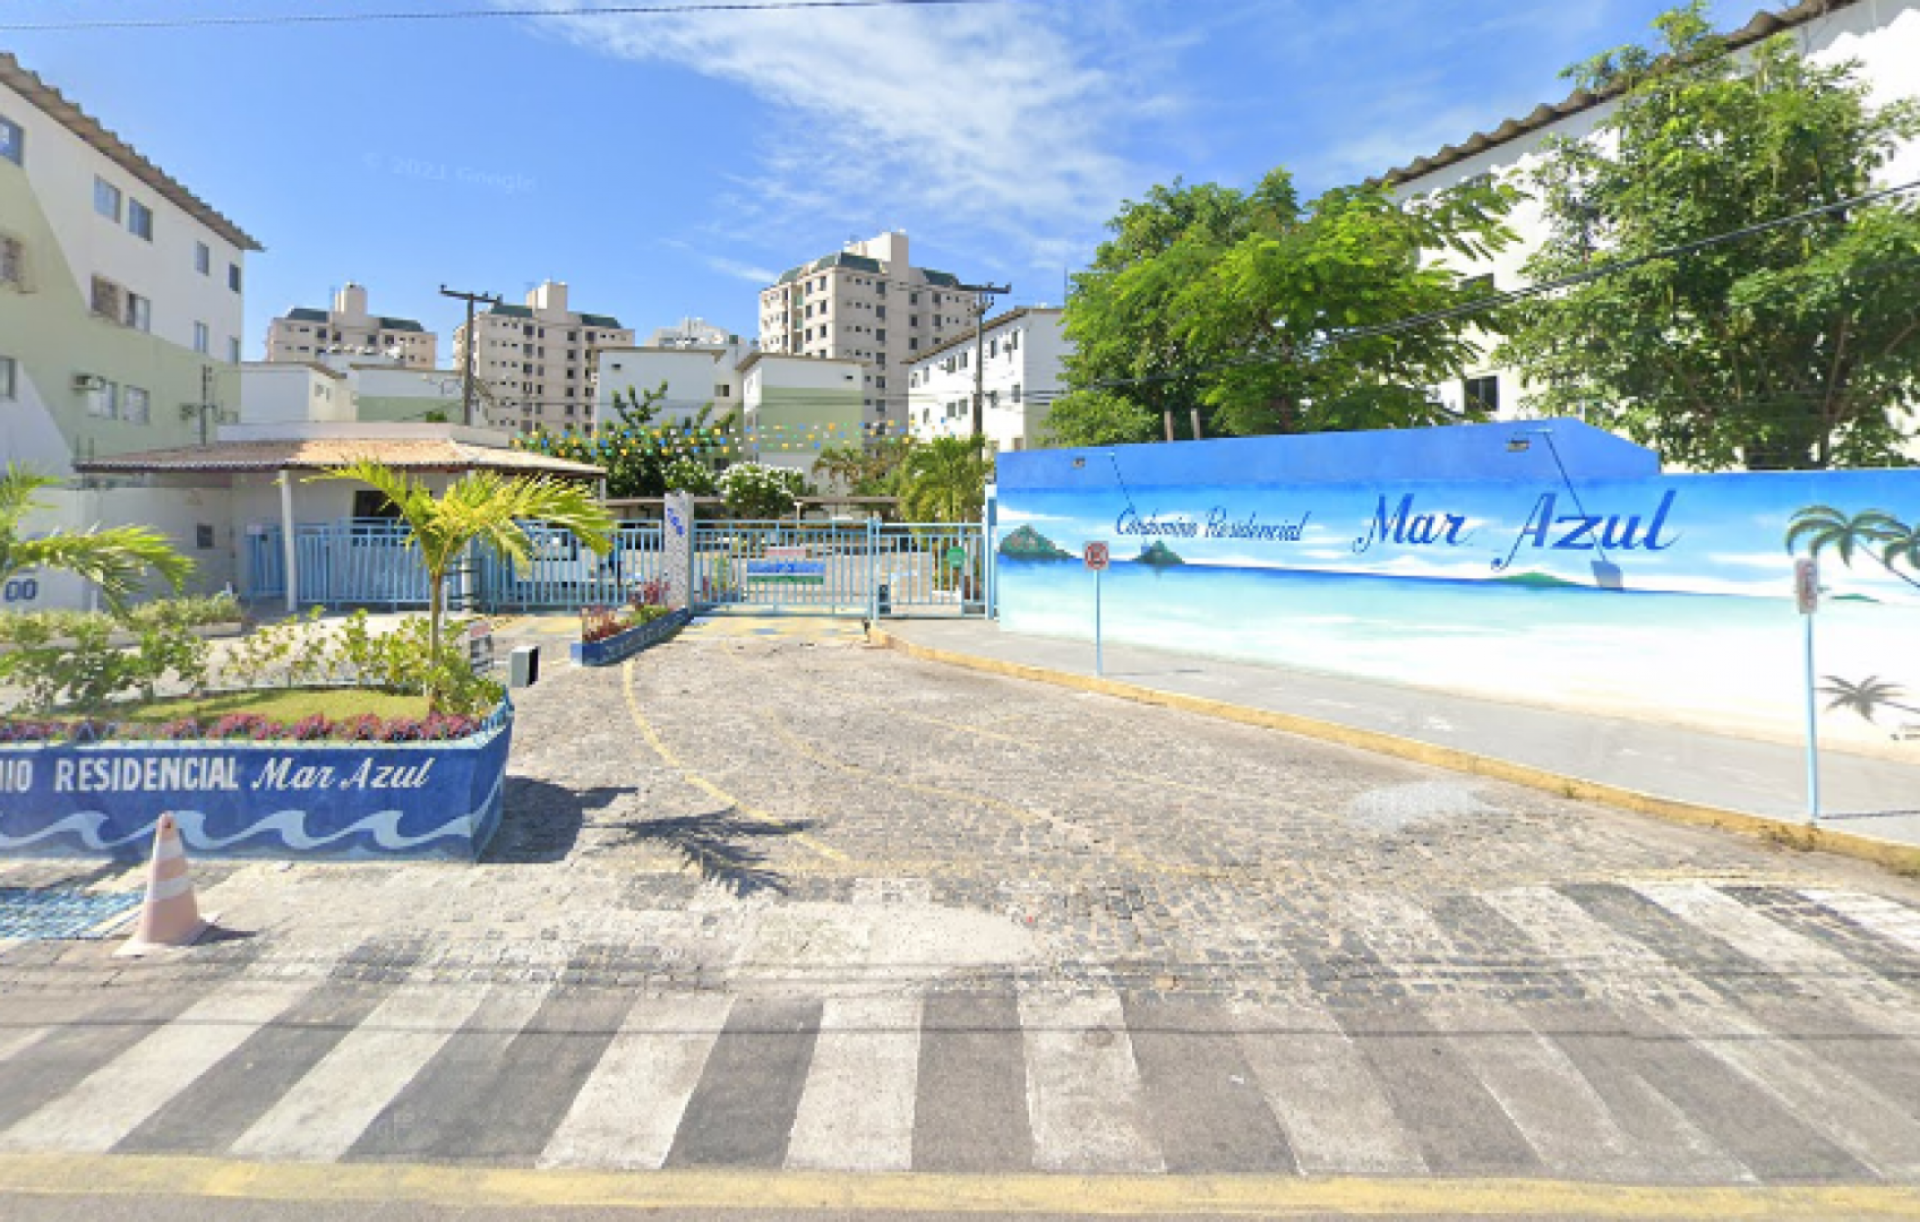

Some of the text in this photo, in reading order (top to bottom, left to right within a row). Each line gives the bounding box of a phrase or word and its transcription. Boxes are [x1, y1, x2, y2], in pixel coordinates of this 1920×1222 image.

[1352, 488, 1684, 571] Mar Azul
[0, 757, 436, 793] IO RESIDENCIAL Mar Azul
